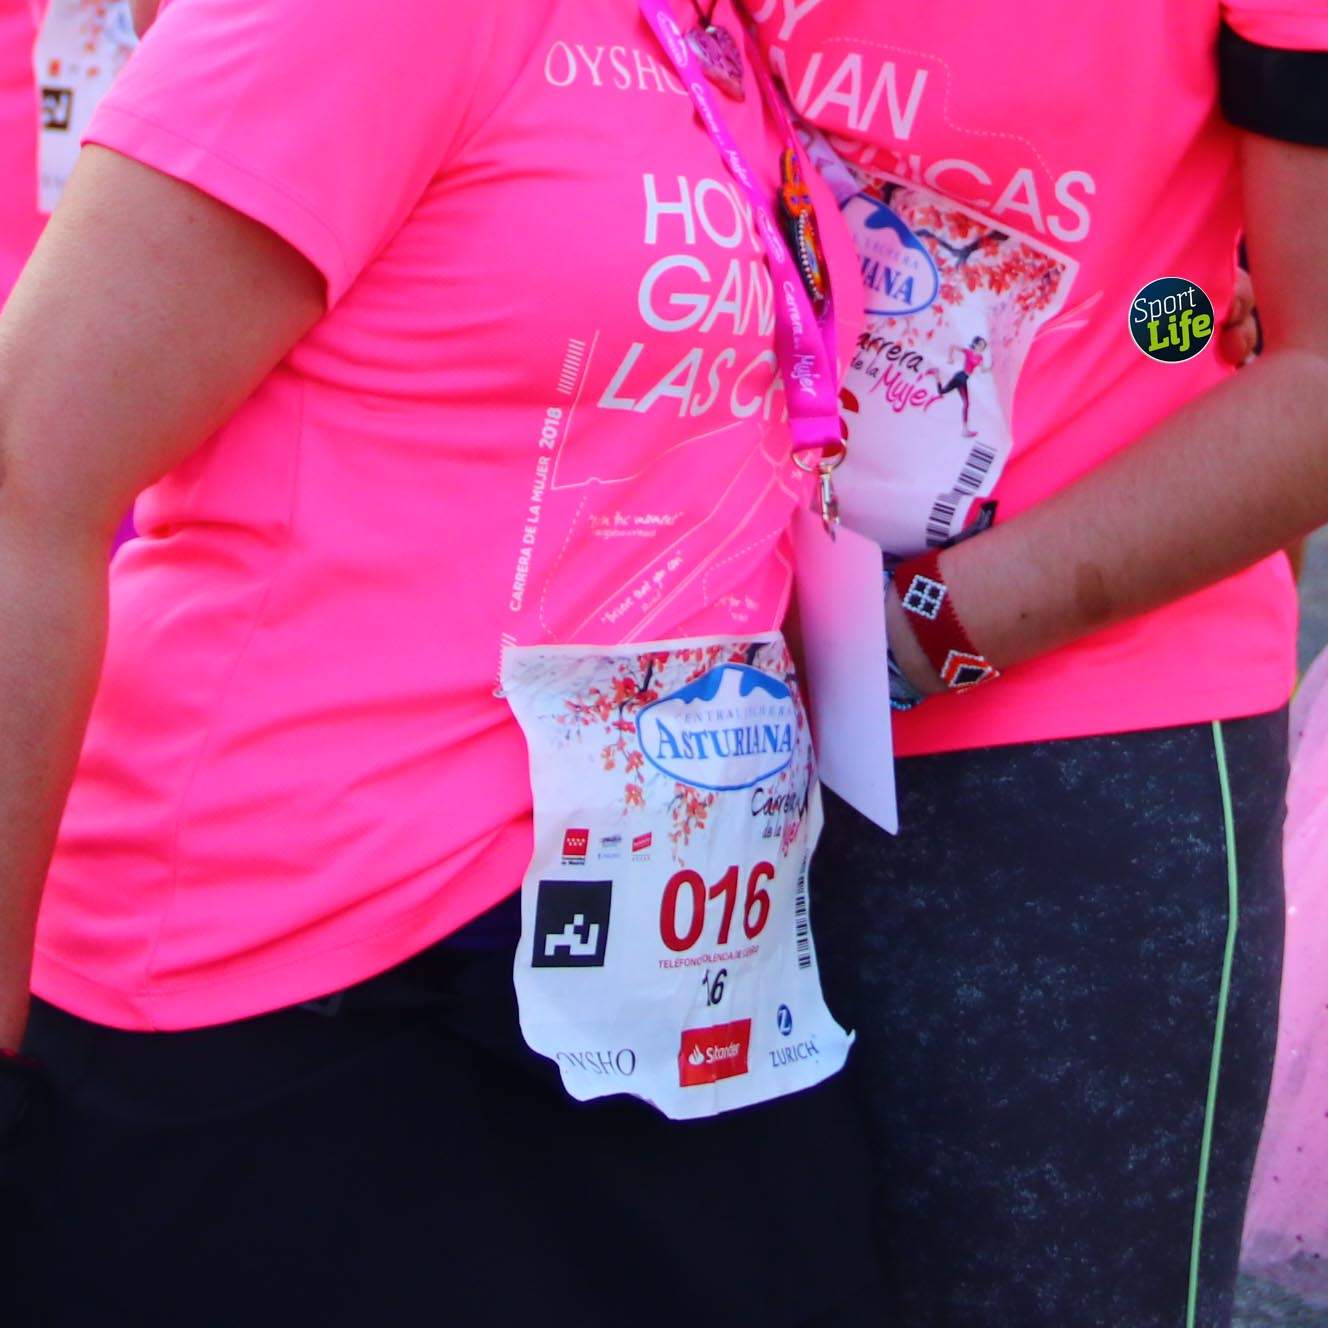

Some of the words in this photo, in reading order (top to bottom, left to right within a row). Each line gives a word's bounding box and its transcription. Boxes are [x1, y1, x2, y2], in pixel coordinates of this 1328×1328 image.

[638, 254, 778, 336] GAN
[1134, 286, 1198, 323] Sport
[856, 331, 923, 373] arrera
[1147, 309, 1212, 352] Life
[598, 343, 732, 418] LAS
[869, 363, 945, 413] Mujer
[538, 405, 564, 451] 2018
[530, 455, 551, 504] MUJER
[522, 523, 537, 547] DE
[527, 504, 542, 525] LA
[509, 547, 532, 613] CARRERA
[656, 716, 793, 760] ASTURIANA
[659, 860, 776, 953] 016
[768, 1040, 820, 1069] ZURICH
